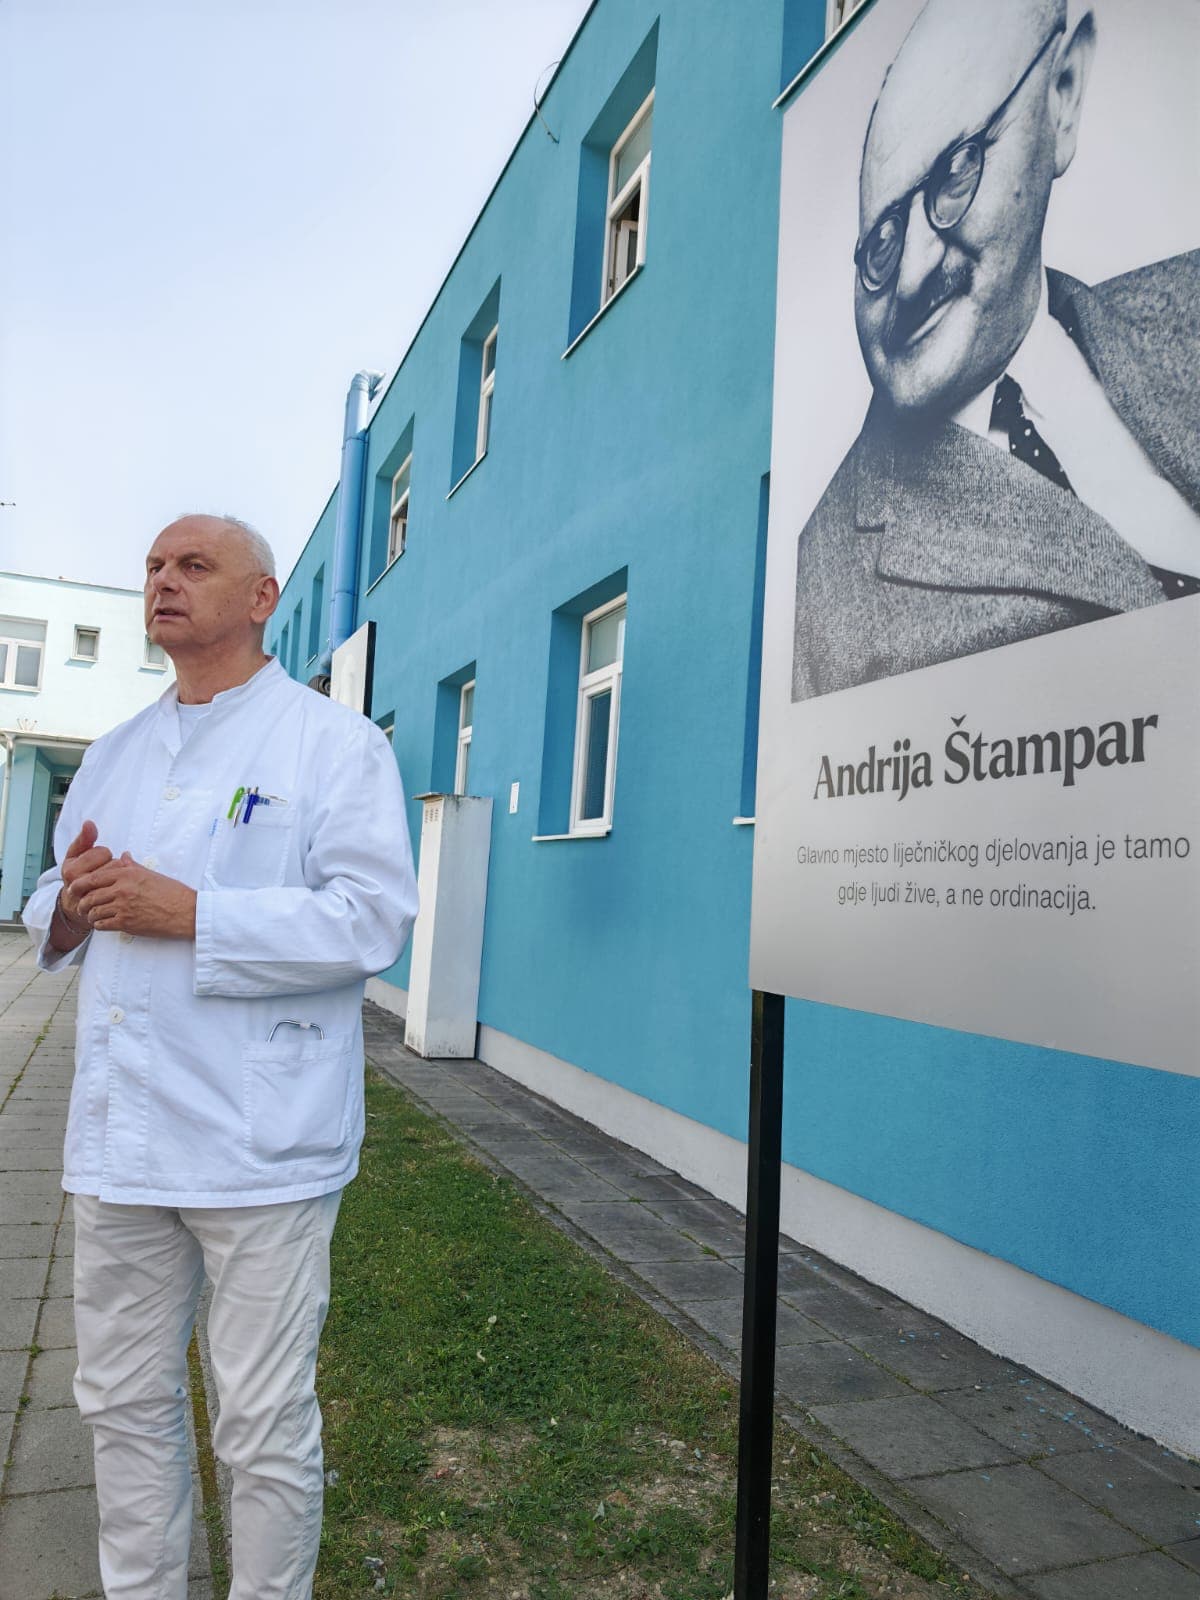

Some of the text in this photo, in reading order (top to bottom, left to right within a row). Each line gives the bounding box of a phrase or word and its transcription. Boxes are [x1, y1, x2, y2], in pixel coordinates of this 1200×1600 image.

[813, 714, 1159, 802] Andrija Štampar
[797, 833, 1191, 868] Glavno mjesto liječničkog djelovanja je tamo
[838, 880, 1096, 916] gdje ljudi žive, a ne ordinacija.
